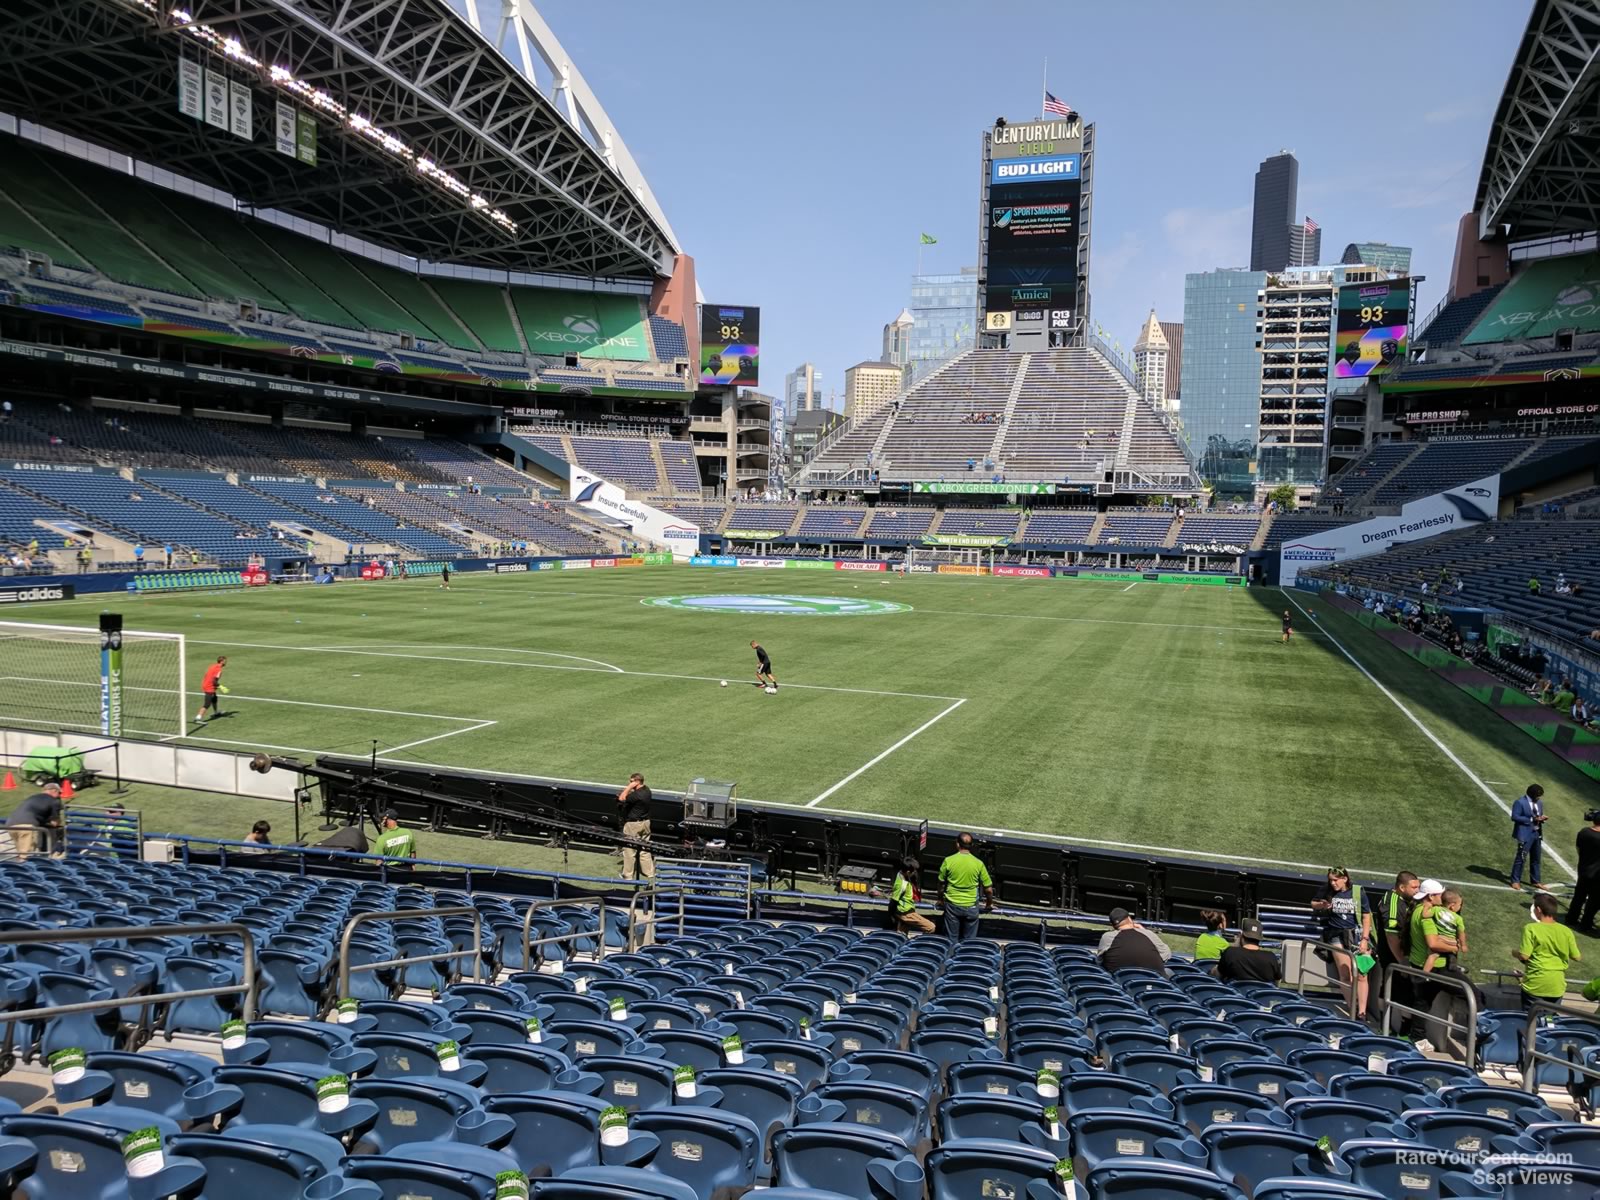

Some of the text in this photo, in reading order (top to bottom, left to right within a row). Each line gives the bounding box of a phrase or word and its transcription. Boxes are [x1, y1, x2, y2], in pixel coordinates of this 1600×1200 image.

[994, 122, 1080, 144] CENTURYLINK
[1019, 142, 1055, 154] FIELD
[998, 161, 1074, 177] BUD LIGHT
[1013, 204, 1069, 217] SPORTSMANSHIP
[1014, 290, 1049, 299] Amica
[1052, 310, 1070, 320] Q13
[1361, 305, 1383, 323] 93
[1052, 319, 1069, 327] FOX
[721, 325, 740, 341] 93
[535, 331, 639, 347] XBOX ONE
[341, 355, 353, 365] VS
[525, 382, 537, 390] VS
[513, 407, 558, 417] THE PRO SHOP
[1422, 411, 1438, 419] PRO
[1439, 410, 1461, 419] SHOP
[1517, 408, 1553, 416] OFFICIAL
[1556, 406, 1585, 414] STORE
[601, 414, 627, 422] OFFICIAL
[1428, 435, 1474, 443] BROTHERTON
[939, 485, 1028, 493] XBOX GREEN ZONE
[598, 495, 649, 522] Insure Carefully
[1361, 513, 1454, 543] Dream Fearlessly
[510, 564, 528, 572] adidas
[18, 588, 63, 600] adidas
[112, 669, 120, 683] FC
[386, 835, 409, 848] SECURITY
